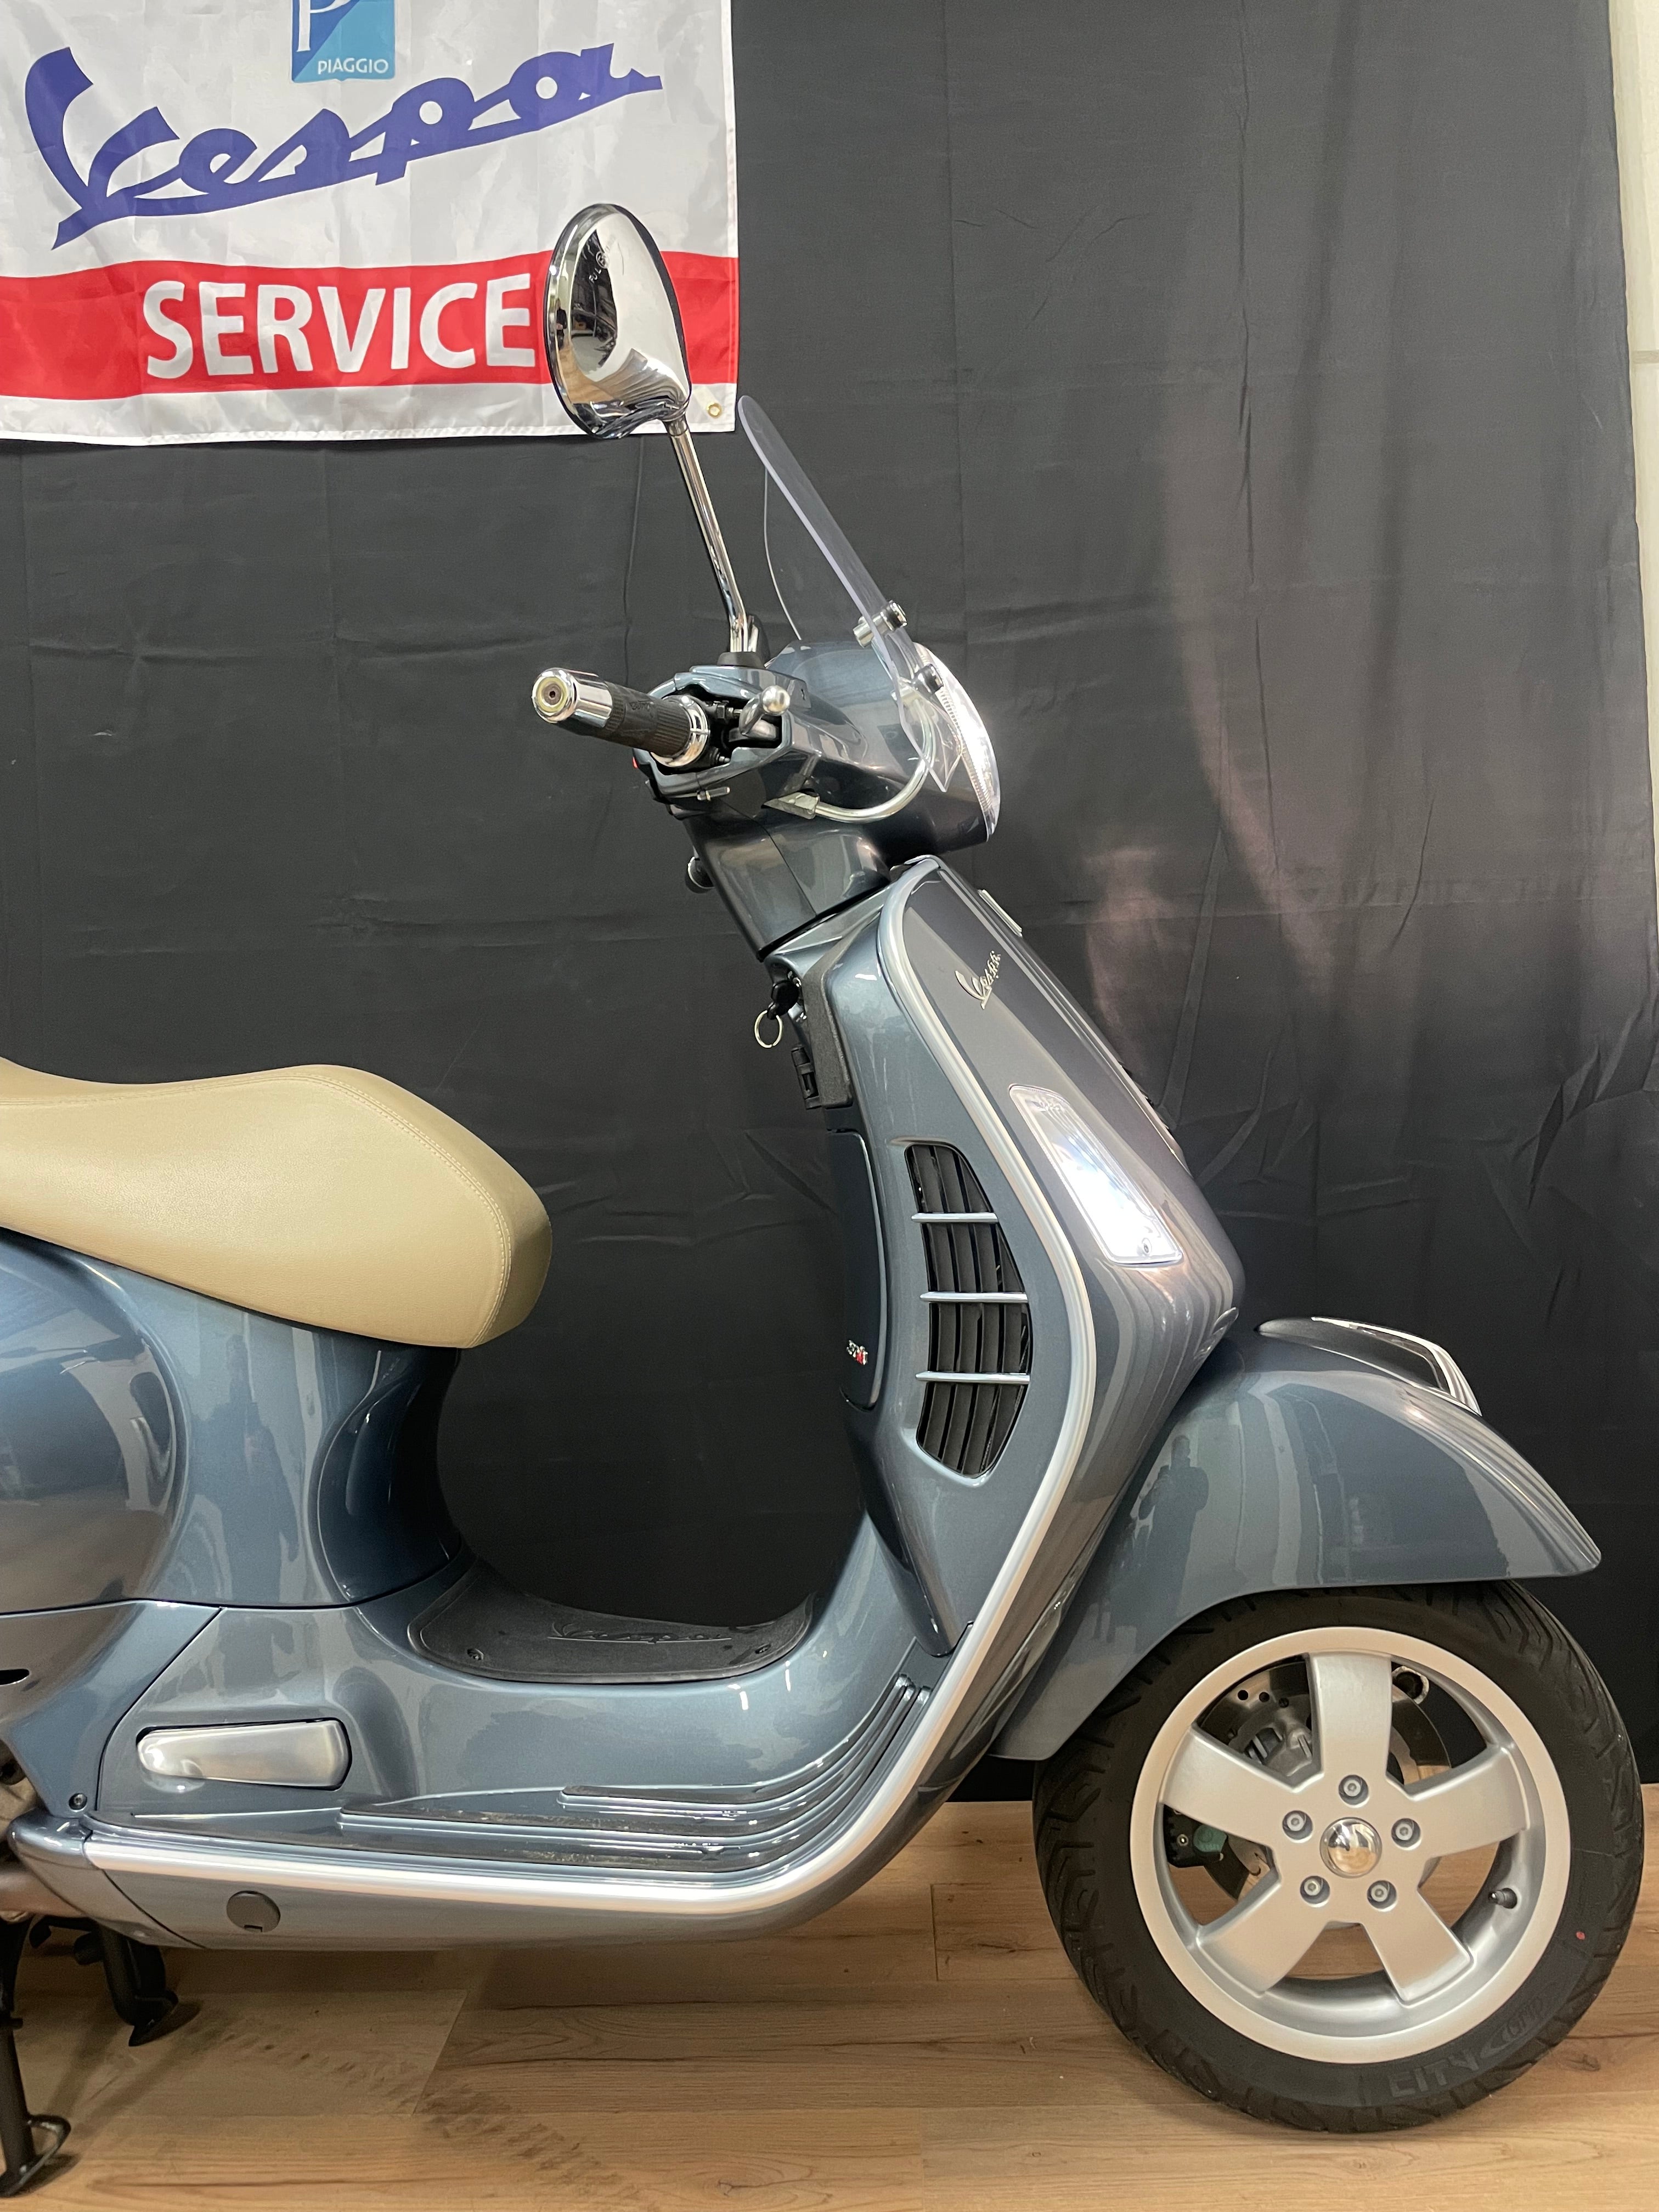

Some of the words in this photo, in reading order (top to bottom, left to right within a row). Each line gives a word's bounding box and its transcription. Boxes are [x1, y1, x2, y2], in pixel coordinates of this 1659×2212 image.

[318, 58, 389, 75] PIAGGIO
[25, 43, 663, 250] Vespa
[143, 273, 535, 380] SERVICE
[955, 950, 1001, 1009] Vespa
